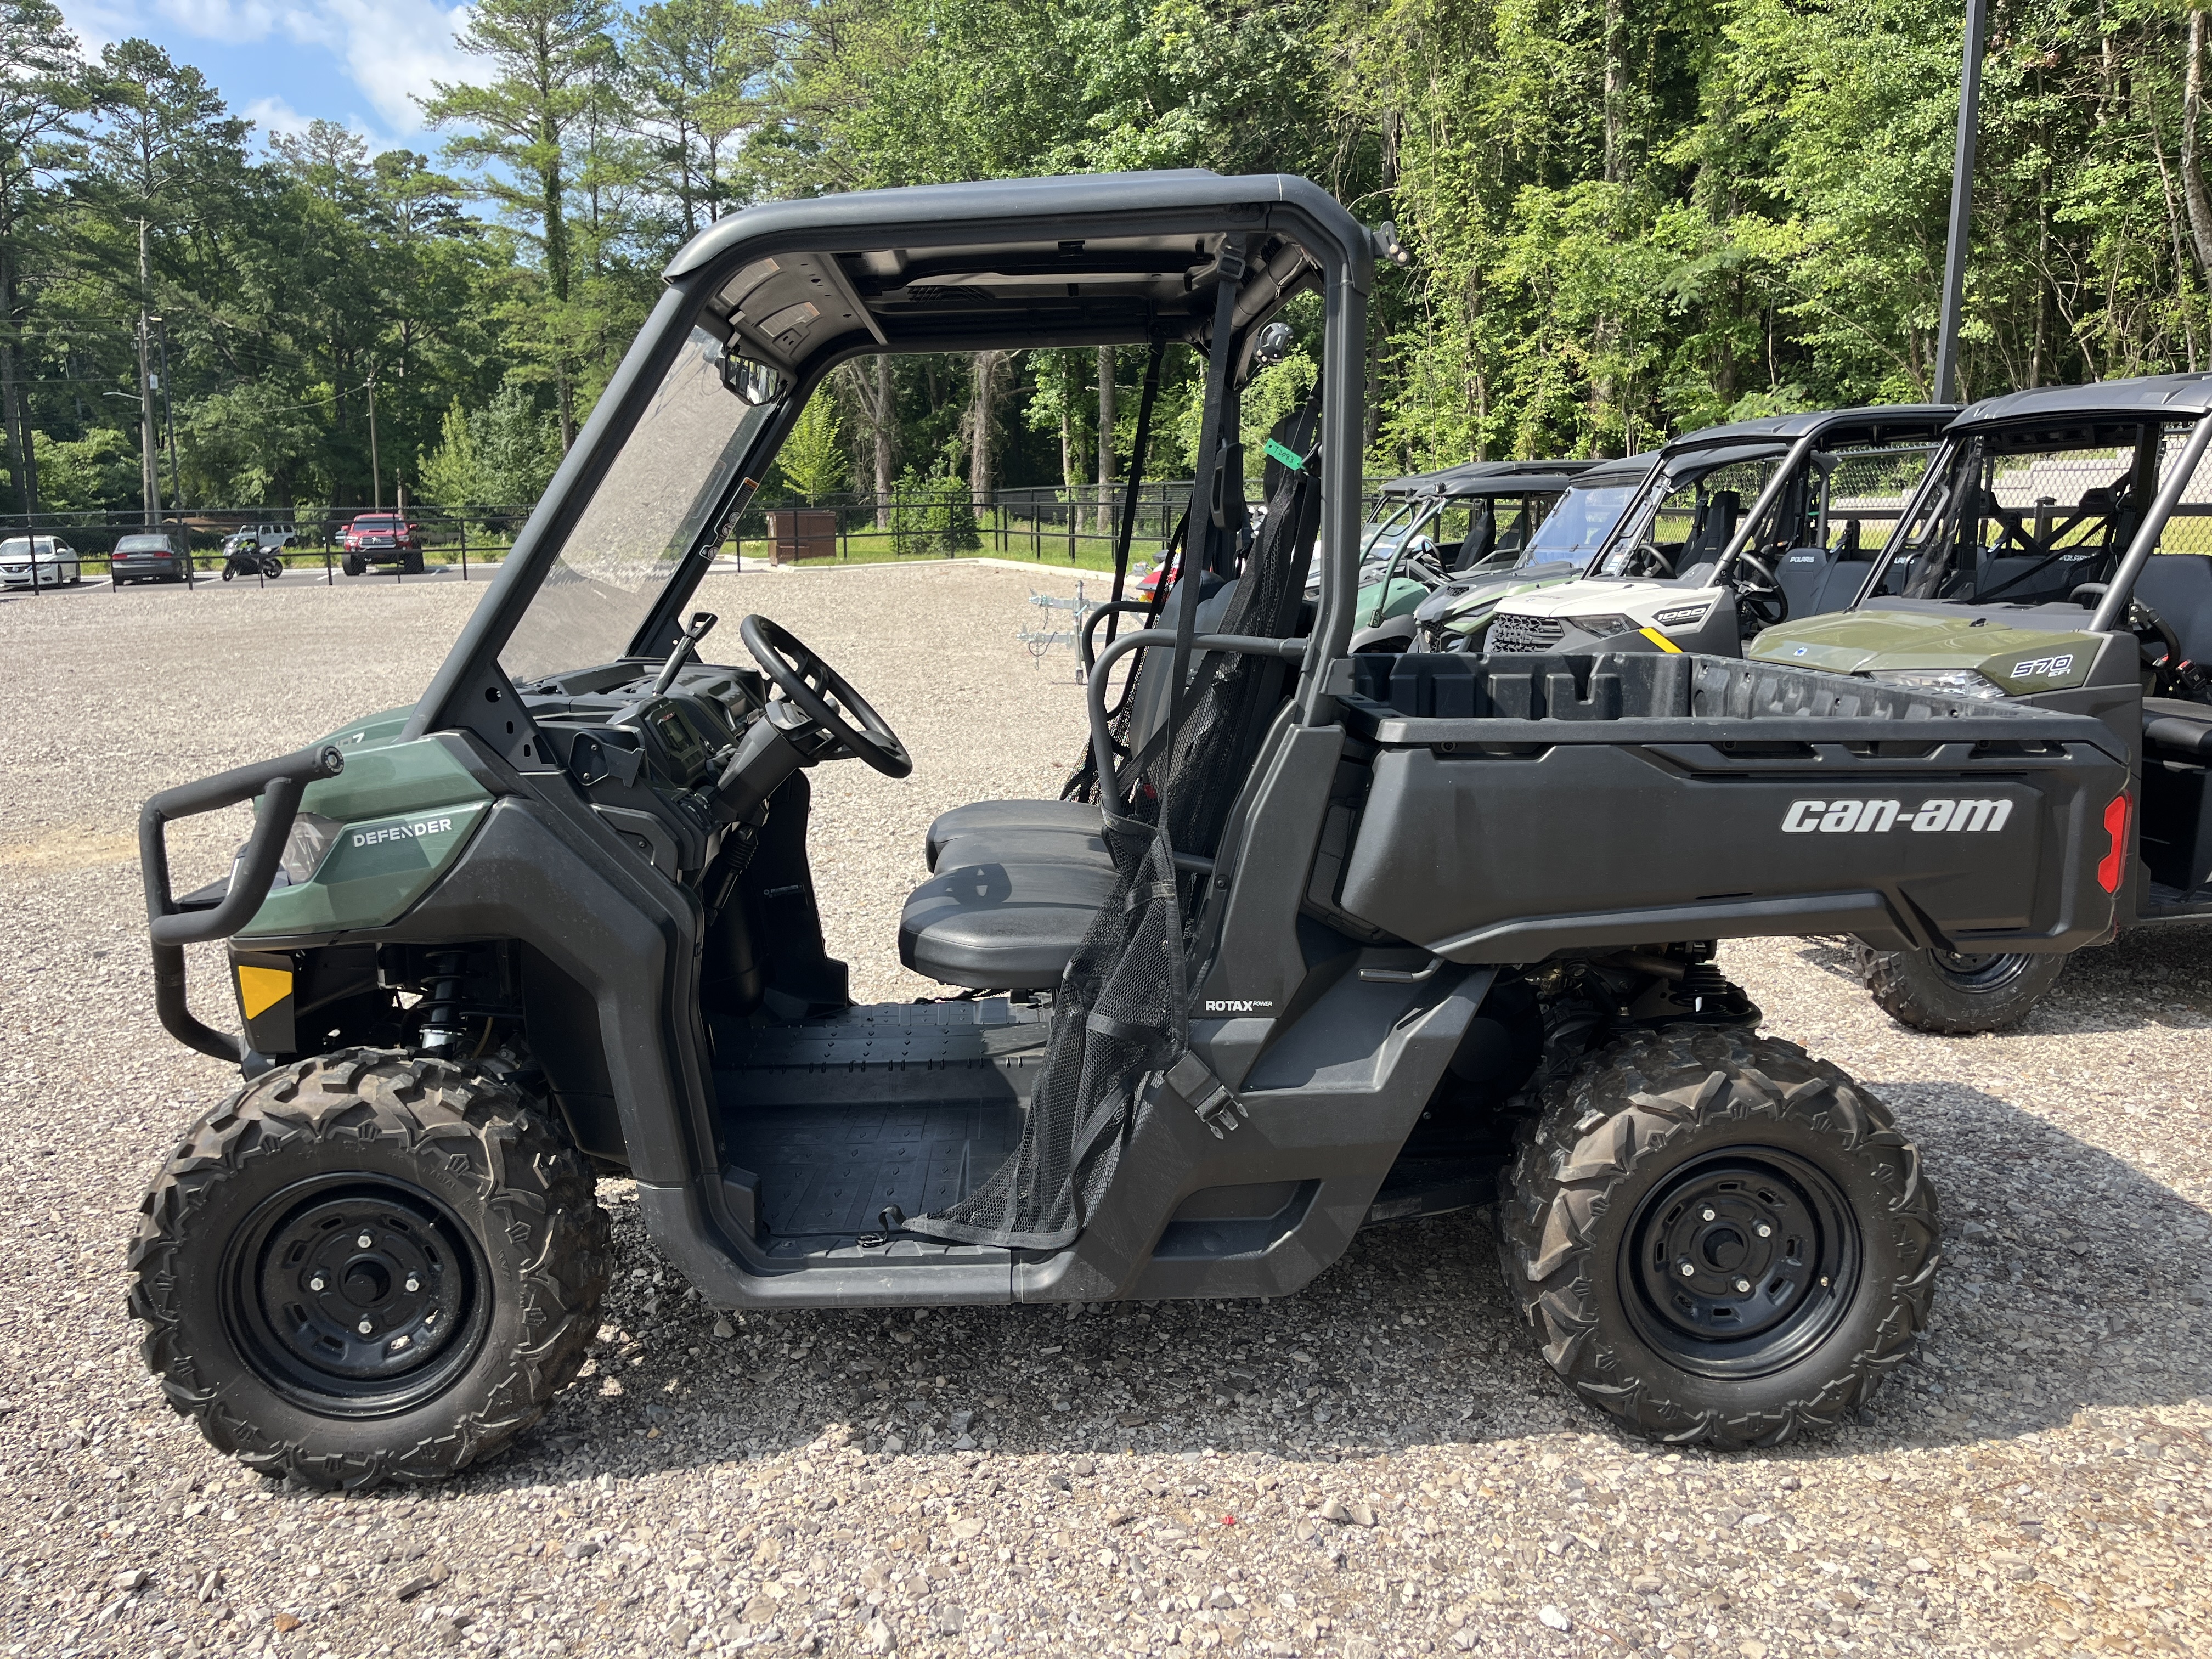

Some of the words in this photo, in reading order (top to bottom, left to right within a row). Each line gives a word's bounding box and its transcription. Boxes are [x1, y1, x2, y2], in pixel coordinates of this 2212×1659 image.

[1657, 607, 1706, 620] 1000
[2010, 654, 2074, 679] 570
[2047, 668, 2071, 678] EFI
[1781, 799, 2014, 833] can-am
[353, 819, 452, 848] DEFENDER
[1205, 1000, 1253, 1012] ROTAX
